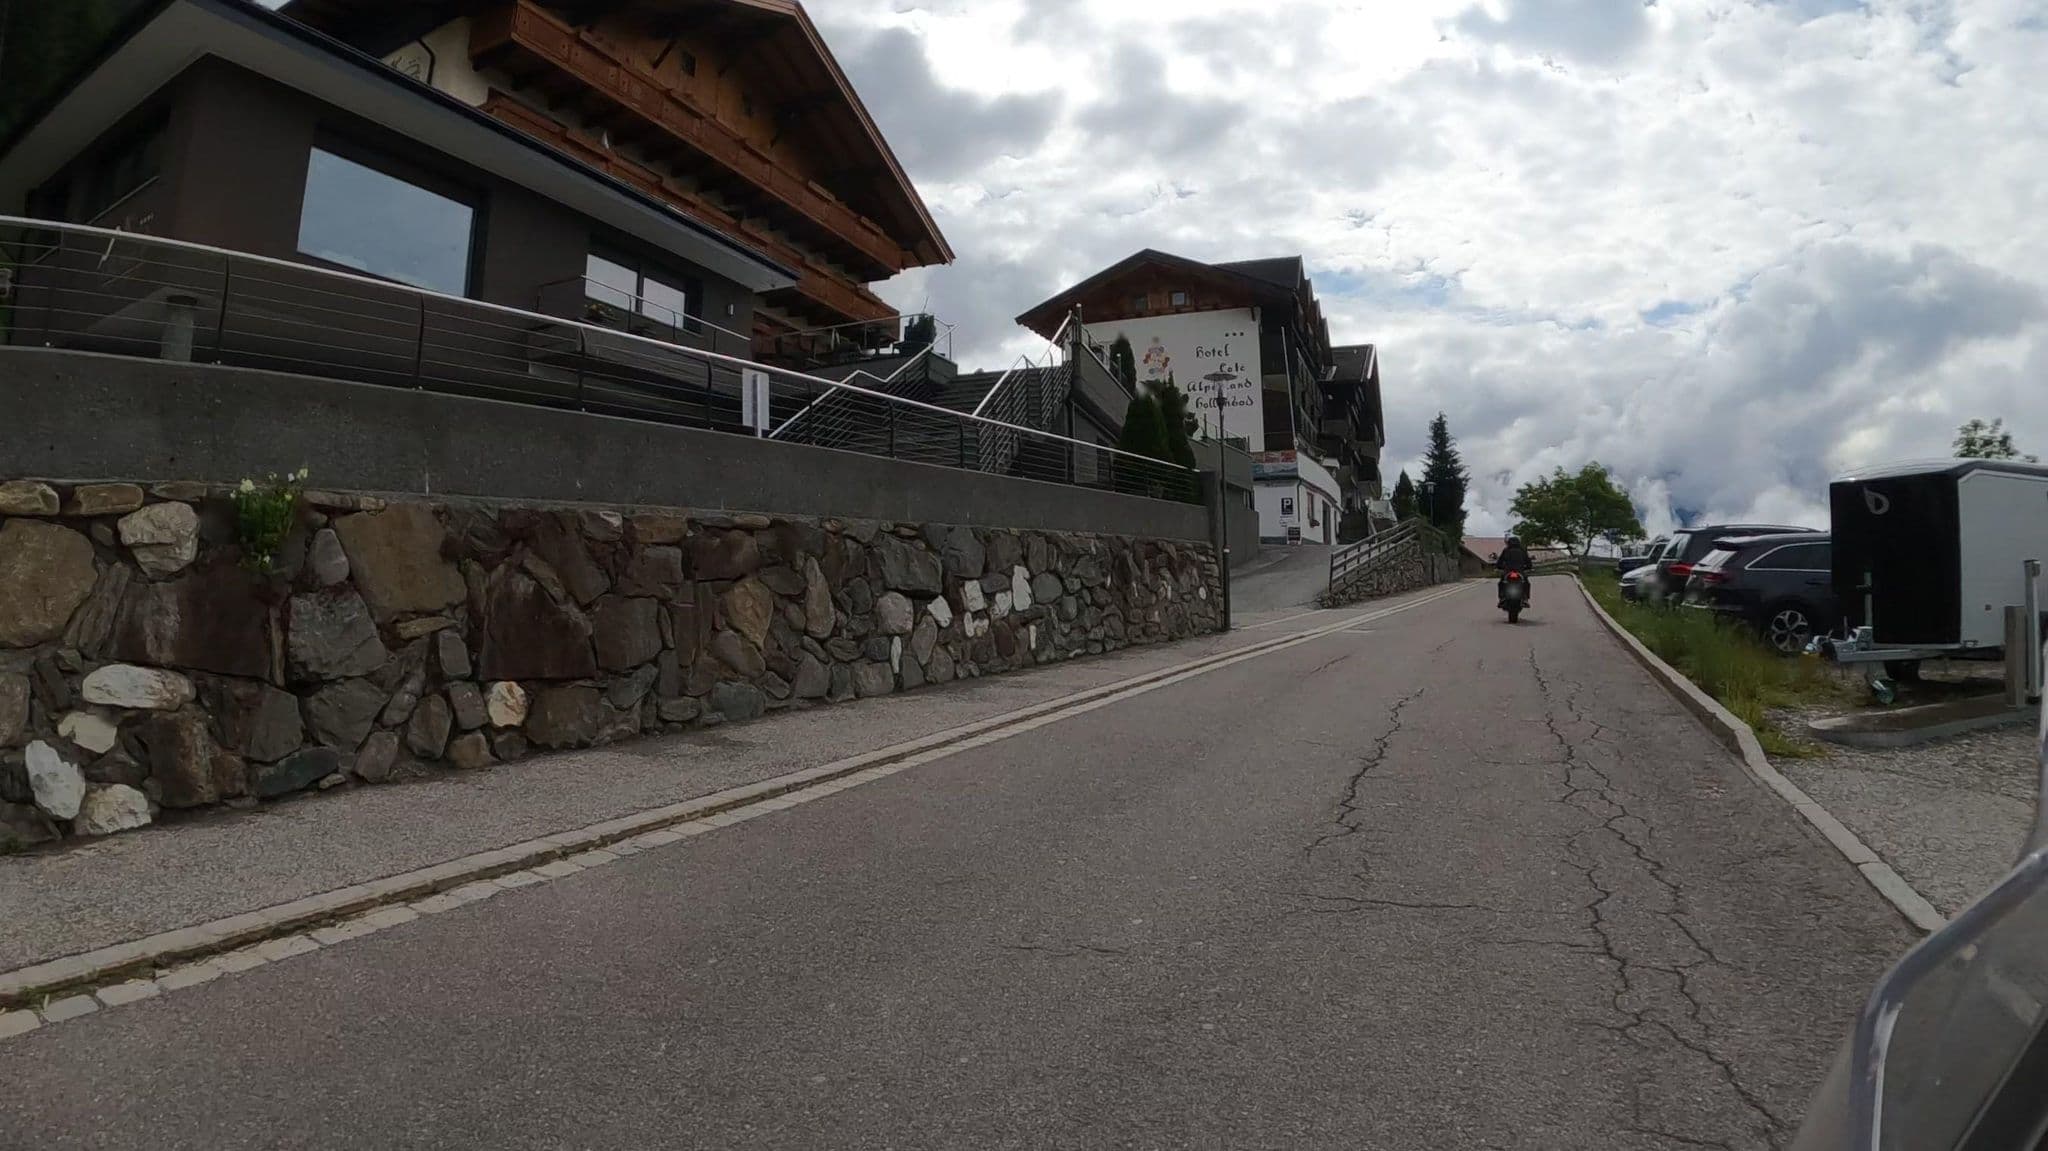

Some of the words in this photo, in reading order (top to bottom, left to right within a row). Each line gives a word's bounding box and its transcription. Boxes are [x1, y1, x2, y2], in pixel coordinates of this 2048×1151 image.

[1196, 343, 1231, 358] Hotel
[1187, 378, 1252, 393] Alpeand
[1195, 395, 1254, 409] Hallnbad
[1283, 499, 1291, 509] P
